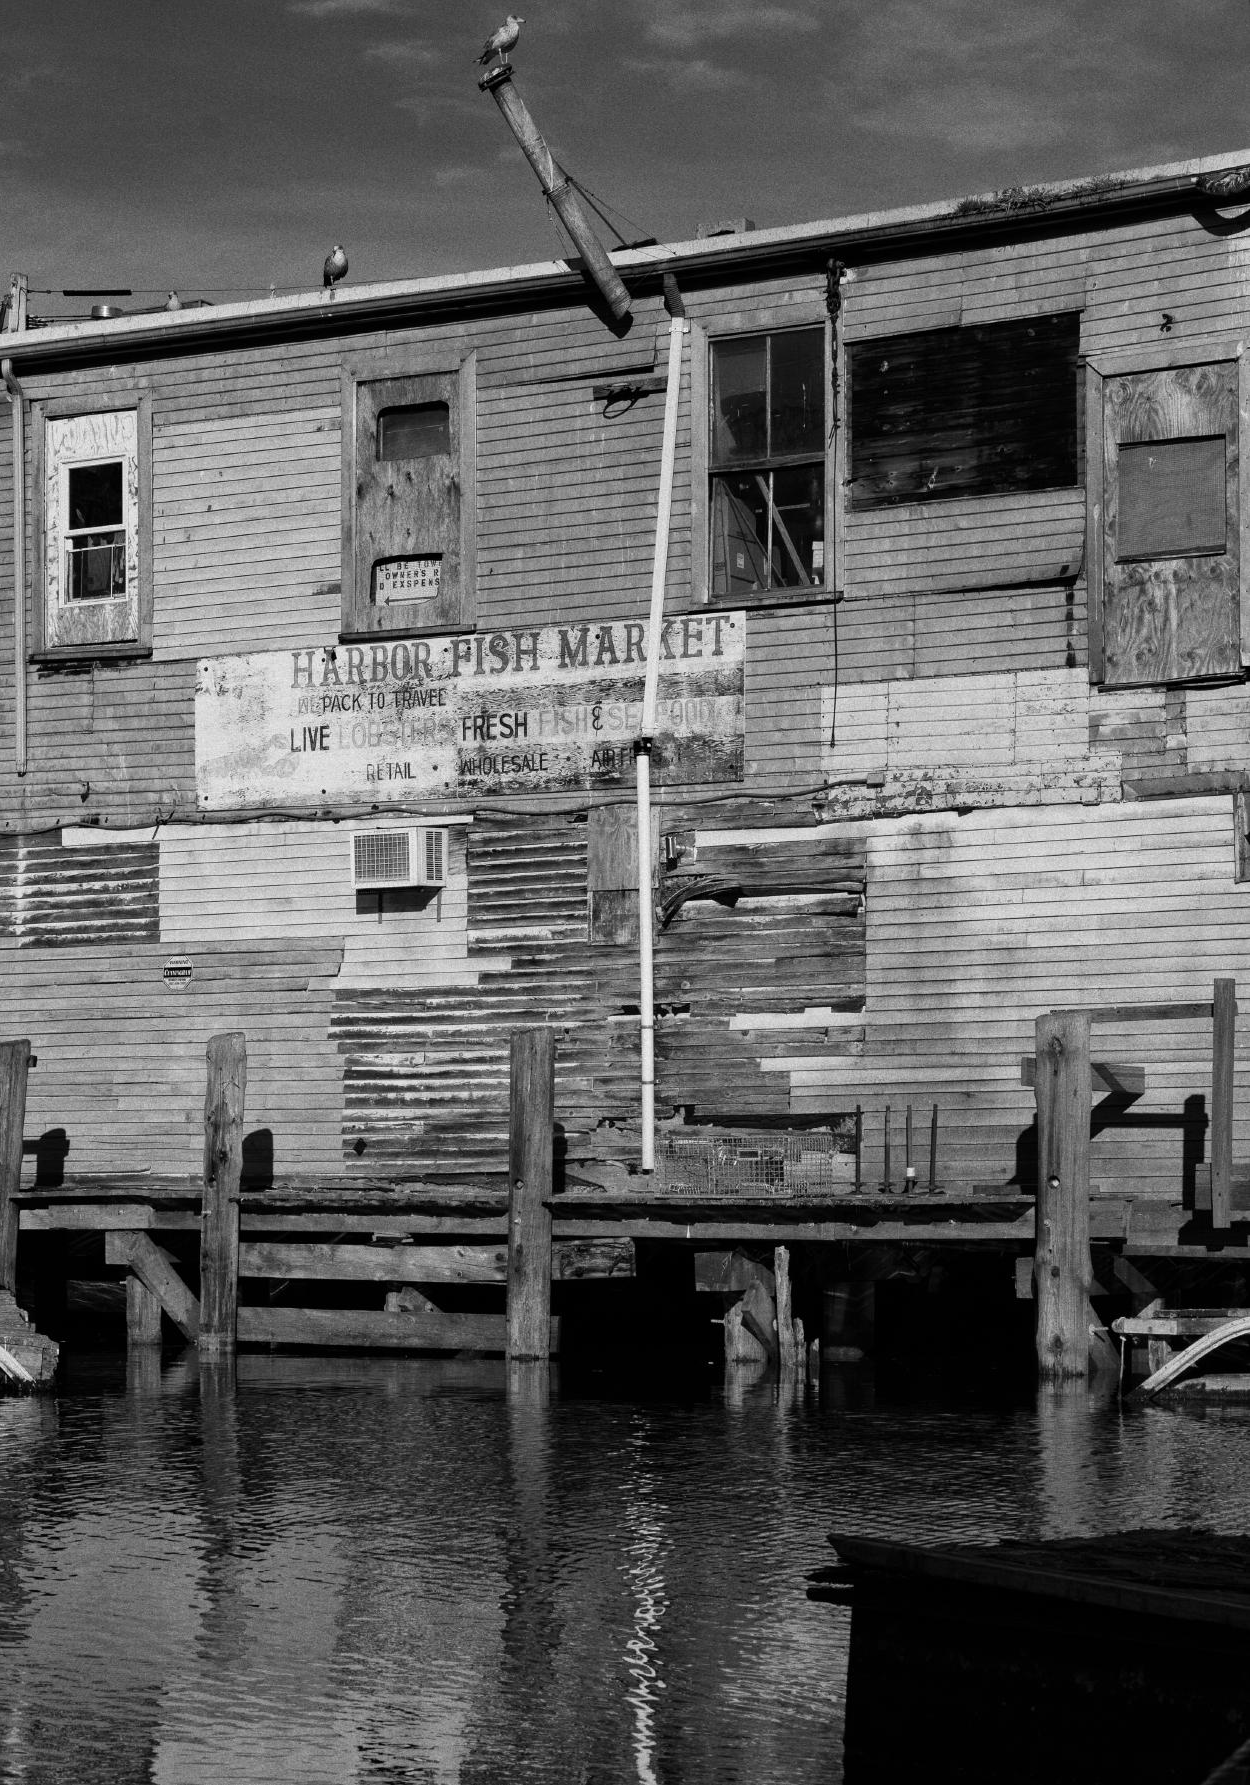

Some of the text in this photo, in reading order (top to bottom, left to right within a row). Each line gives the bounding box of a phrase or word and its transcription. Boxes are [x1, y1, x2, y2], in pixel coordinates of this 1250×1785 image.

[397, 562, 409, 570] BE
[392, 577, 440, 589] EXSPENS
[291, 641, 434, 689] HARBOR
[450, 632, 541, 677] FISH
[321, 693, 362, 713] PACK
[368, 692, 385, 710] TO
[461, 698, 717, 742] FRESH FISH & SEFOOD
[291, 717, 456, 752] LIVE LOBSTERS
[366, 762, 417, 781] RETAIL
[460, 752, 549, 776] WHOLESALE
